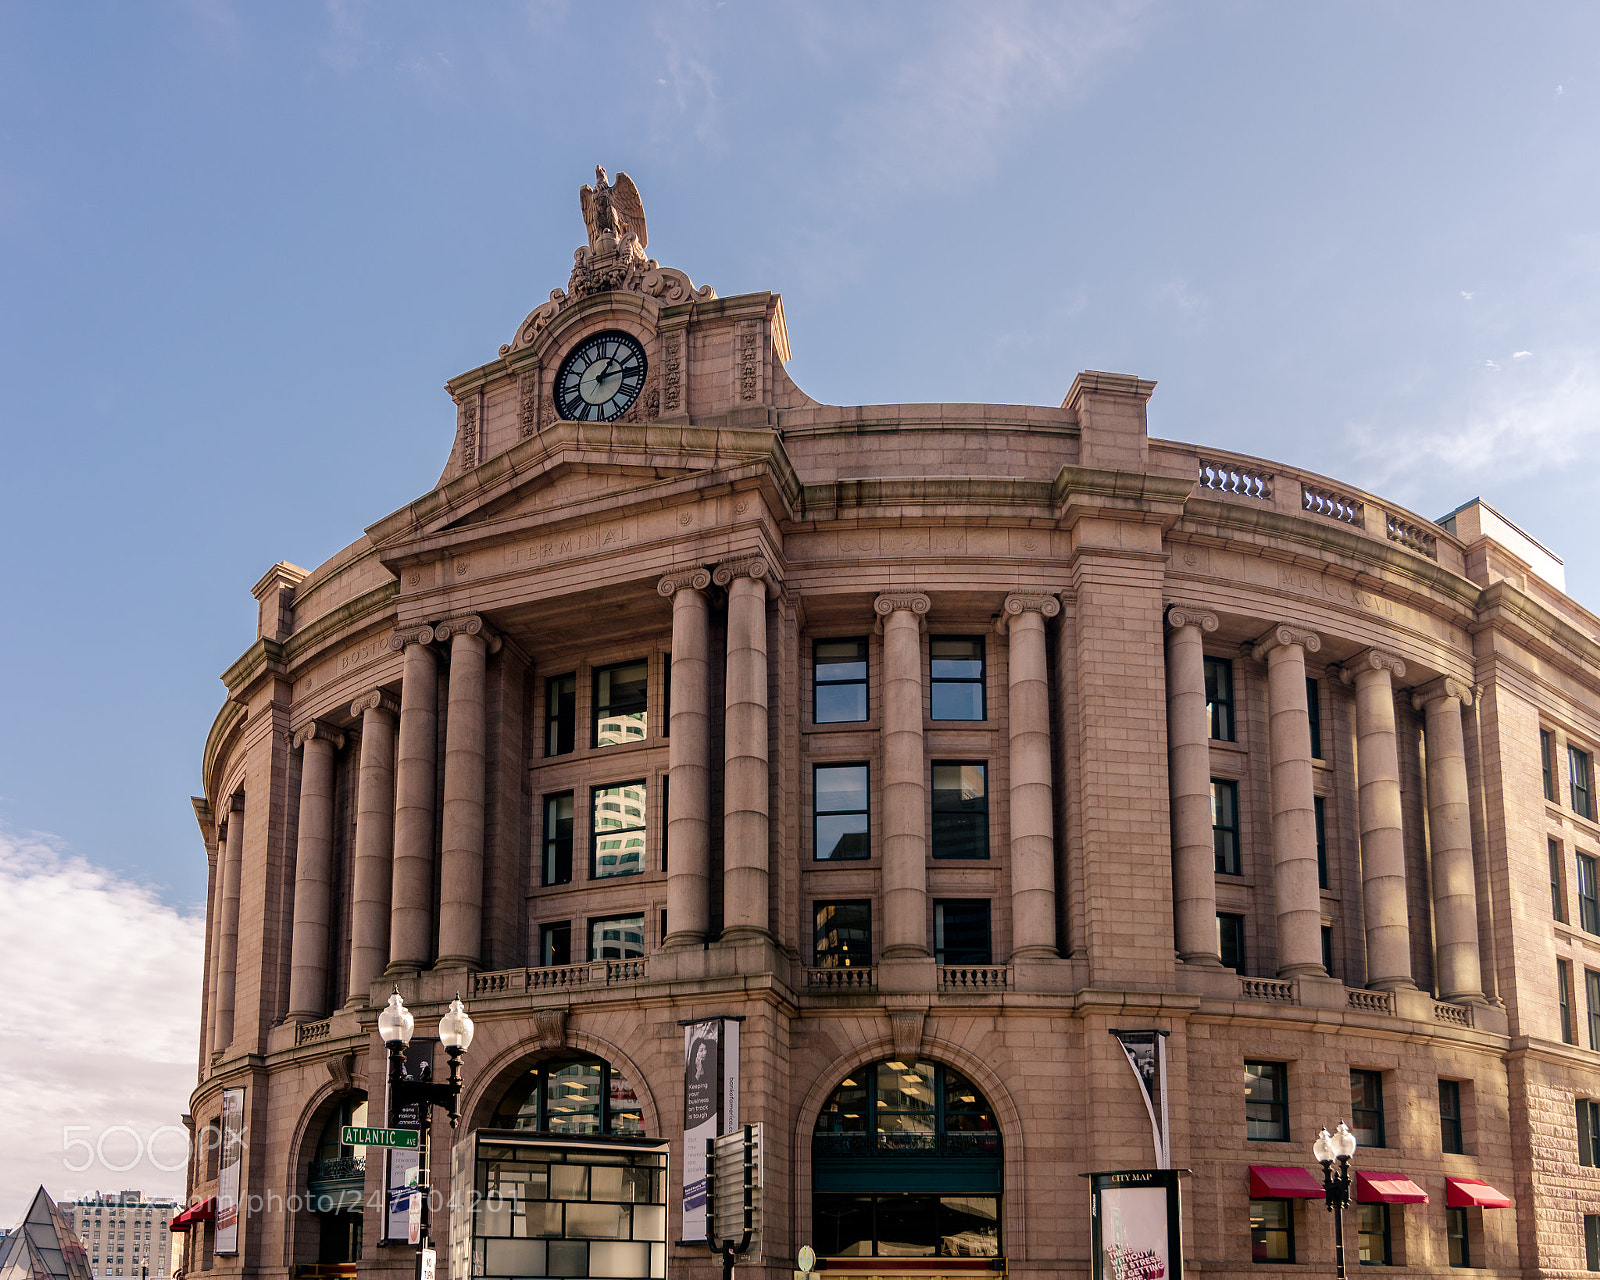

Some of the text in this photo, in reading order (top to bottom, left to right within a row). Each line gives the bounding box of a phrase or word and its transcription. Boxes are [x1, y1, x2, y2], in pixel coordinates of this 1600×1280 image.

[511, 526, 630, 564] TERMINAL
[840, 534, 964, 552] COMPANY
[342, 638, 388, 670] BOSTO
[345, 1128, 416, 1146] ATLANTIC AVE
[1111, 1173, 1152, 1182] CITY MAP
[1109, 1247, 1133, 1259] THERE
[1110, 1250, 1149, 1266] WITHOUT
[1113, 1255, 1161, 1274] THE STRESS
[1128, 1262, 1165, 1277] GETTING
